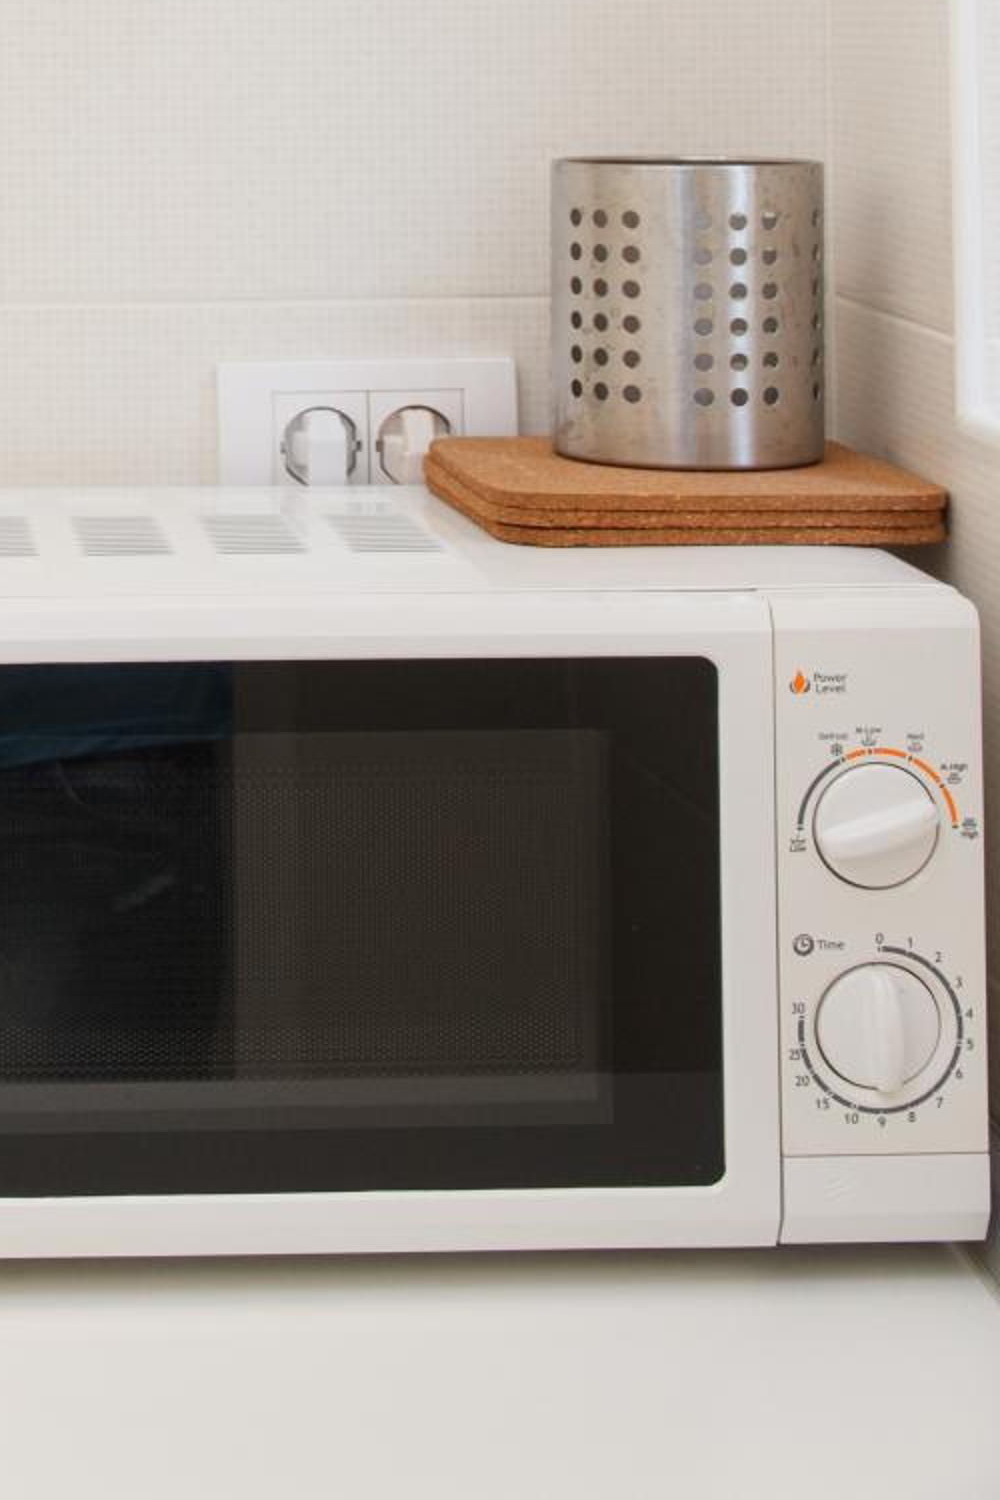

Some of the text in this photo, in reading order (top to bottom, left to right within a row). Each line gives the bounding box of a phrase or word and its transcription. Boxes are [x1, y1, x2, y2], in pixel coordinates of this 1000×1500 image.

[813, 672, 847, 682] Power
[815, 684, 846, 693] Level
[817, 939, 846, 950] Time
[875, 933, 884, 945] 0
[936, 952, 942, 963] 2
[956, 976, 963, 988] 3
[791, 1002, 806, 1014] 30
[966, 1008, 974, 1019] 4
[967, 1039, 975, 1051] 5
[789, 1050, 801, 1061] 25
[955, 1069, 963, 1080] 6
[795, 1075, 810, 1087] 20
[816, 1098, 830, 1109] 15
[936, 1097, 944, 1109] 7
[844, 1113, 859, 1124] 10
[877, 1116, 886, 1128] 9
[908, 1111, 916, 1123] 8
